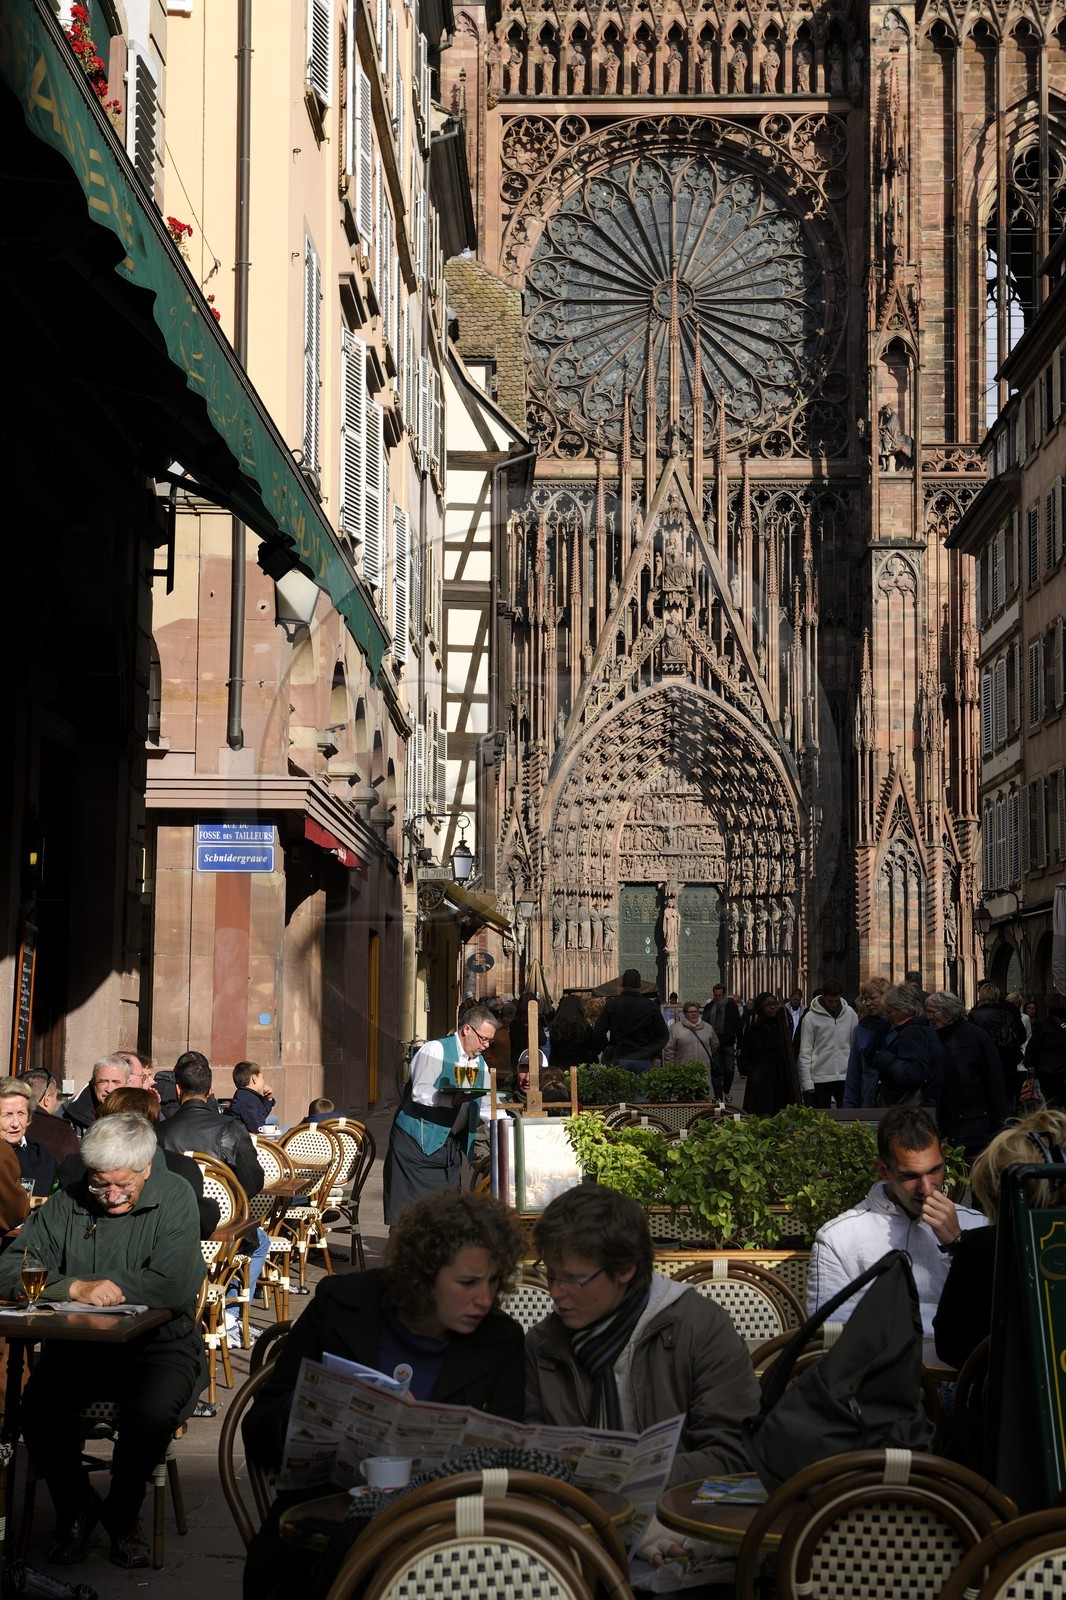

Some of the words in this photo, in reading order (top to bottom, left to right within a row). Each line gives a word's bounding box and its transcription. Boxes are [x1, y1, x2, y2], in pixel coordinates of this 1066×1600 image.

[222, 819, 237, 829] RUE
[237, 819, 250, 829] DU
[199, 831, 220, 840] FOSSE
[234, 831, 273, 840] TAILLEURS
[203, 852, 268, 864] Schnidergrawe
